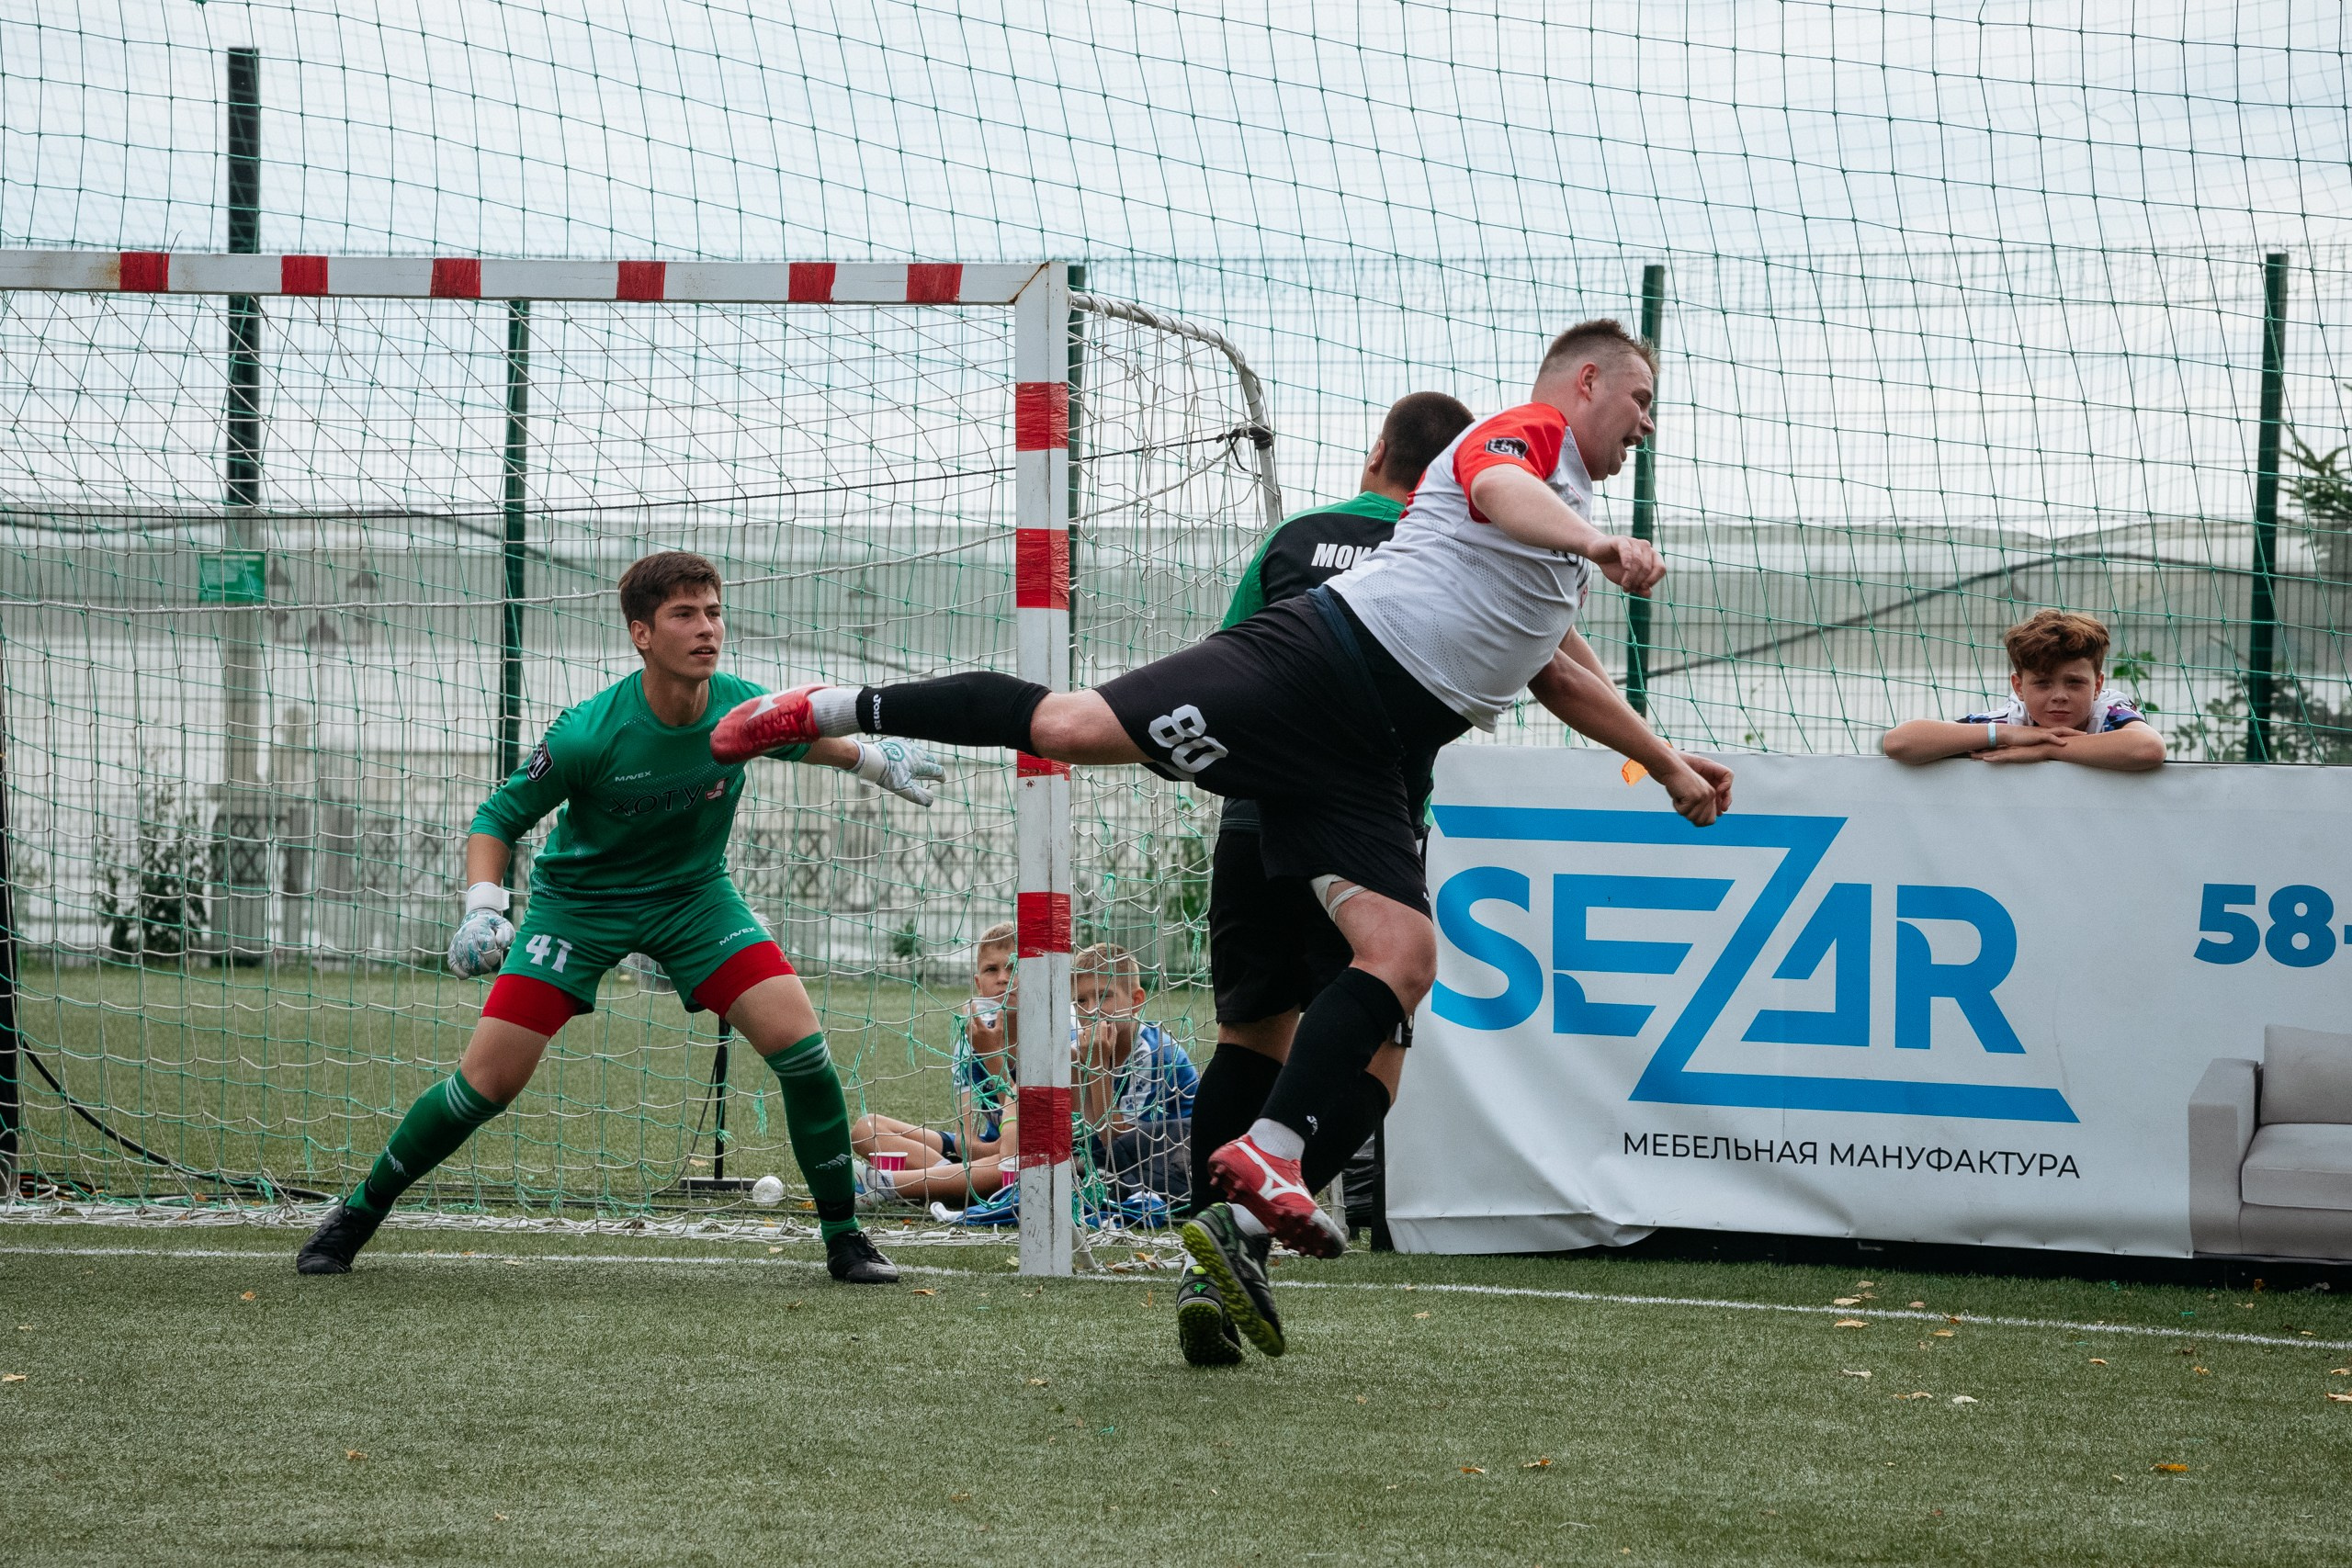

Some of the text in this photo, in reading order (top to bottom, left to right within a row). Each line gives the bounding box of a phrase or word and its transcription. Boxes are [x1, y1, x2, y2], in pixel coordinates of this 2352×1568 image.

[1148, 704, 1229, 773] 80
[615, 771, 651, 782] MAVEX
[718, 927, 757, 946] MAVEX
[2193, 883, 2352, 968] 58
[526, 933, 573, 974] 41
[1430, 805, 2081, 1122] SEZAR
[1623, 1132, 2081, 1179] МЕБЕЛЬНАЯ МАНУФАКТУРА
